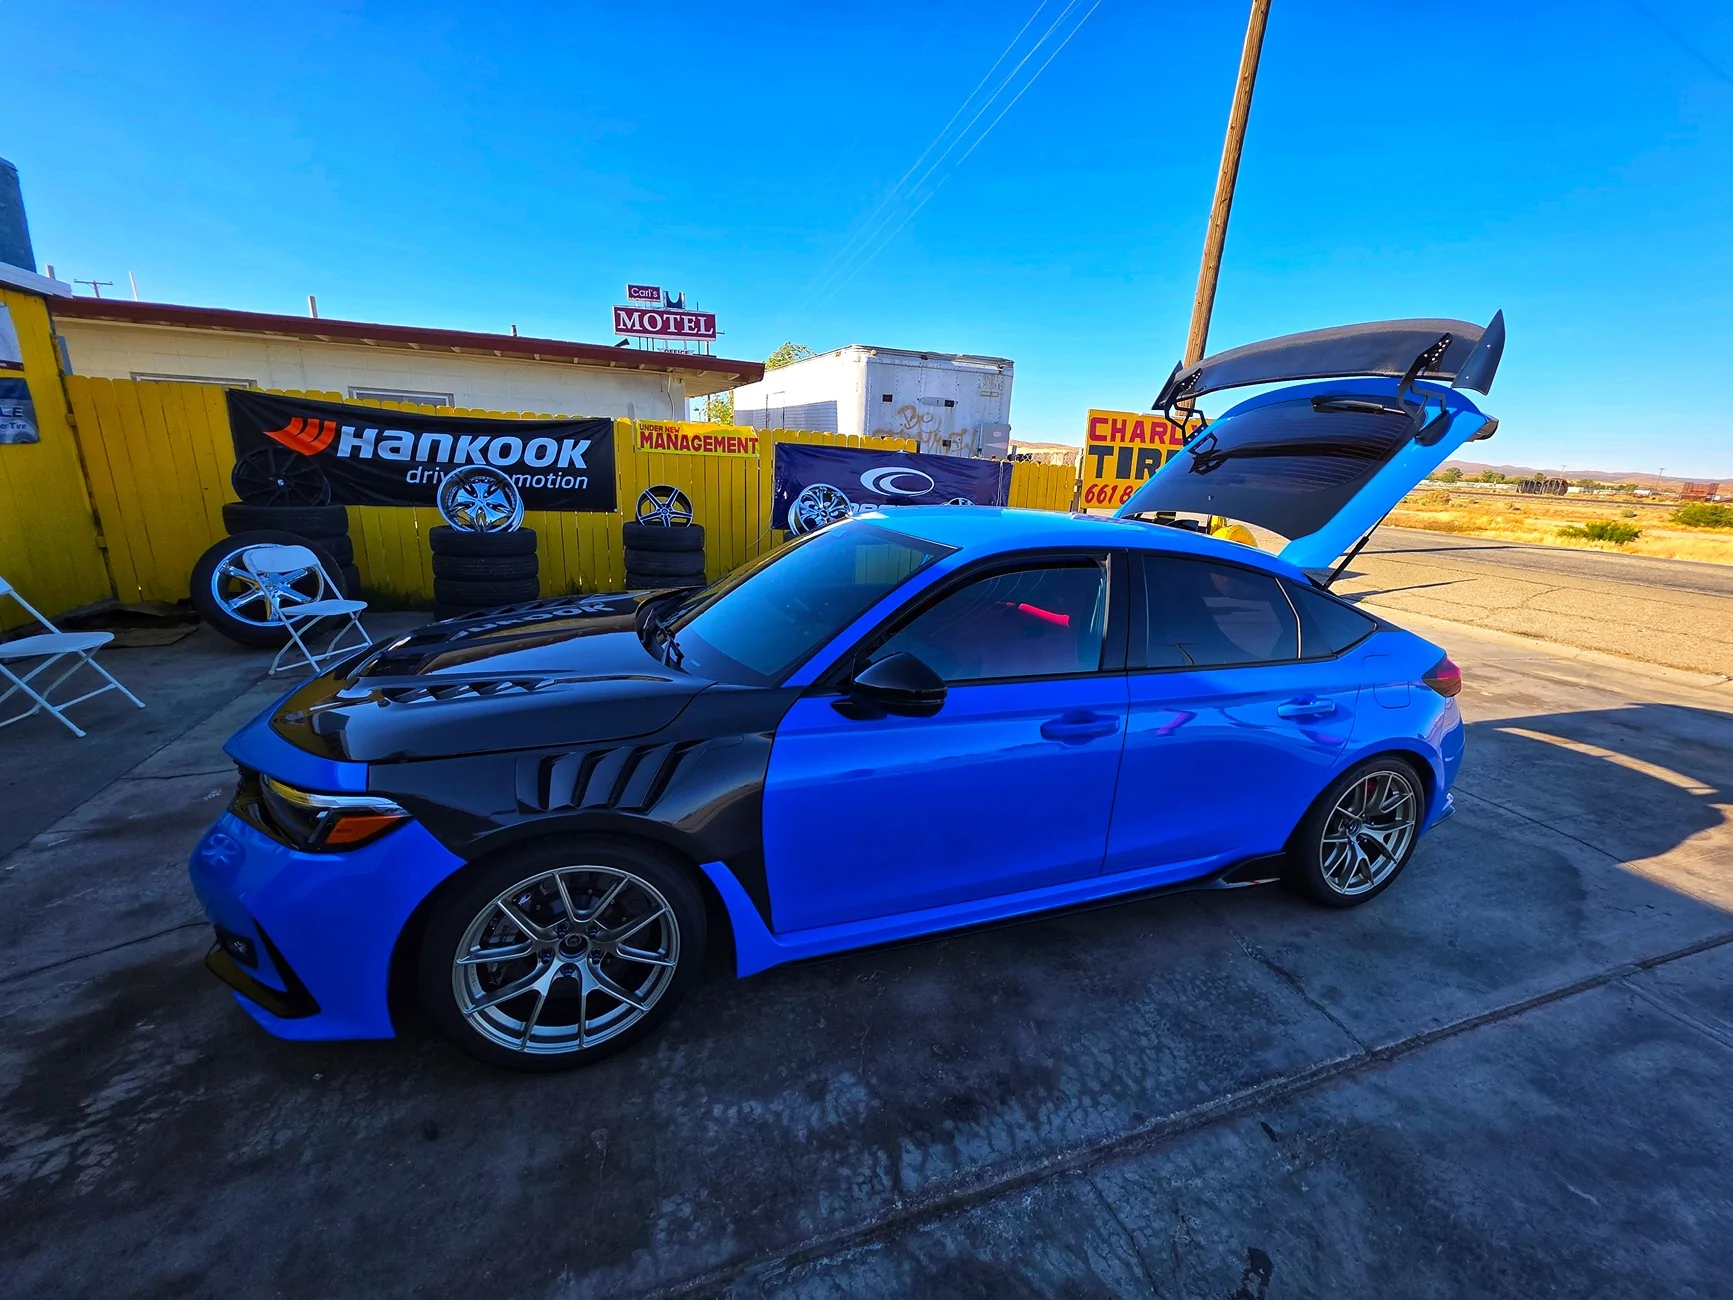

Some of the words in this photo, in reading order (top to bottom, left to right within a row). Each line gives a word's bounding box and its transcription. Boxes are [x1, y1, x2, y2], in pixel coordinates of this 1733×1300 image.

[630, 287, 658, 298] Carl's
[617, 310, 714, 335] MOTEL
[10, 422, 27, 430] Tire
[639, 423, 664, 432] UNDER
[664, 426, 681, 434] NEW
[640, 430, 759, 454] MANAGEMENT
[1088, 444, 1182, 480] TIR
[507, 472, 588, 490] motion
